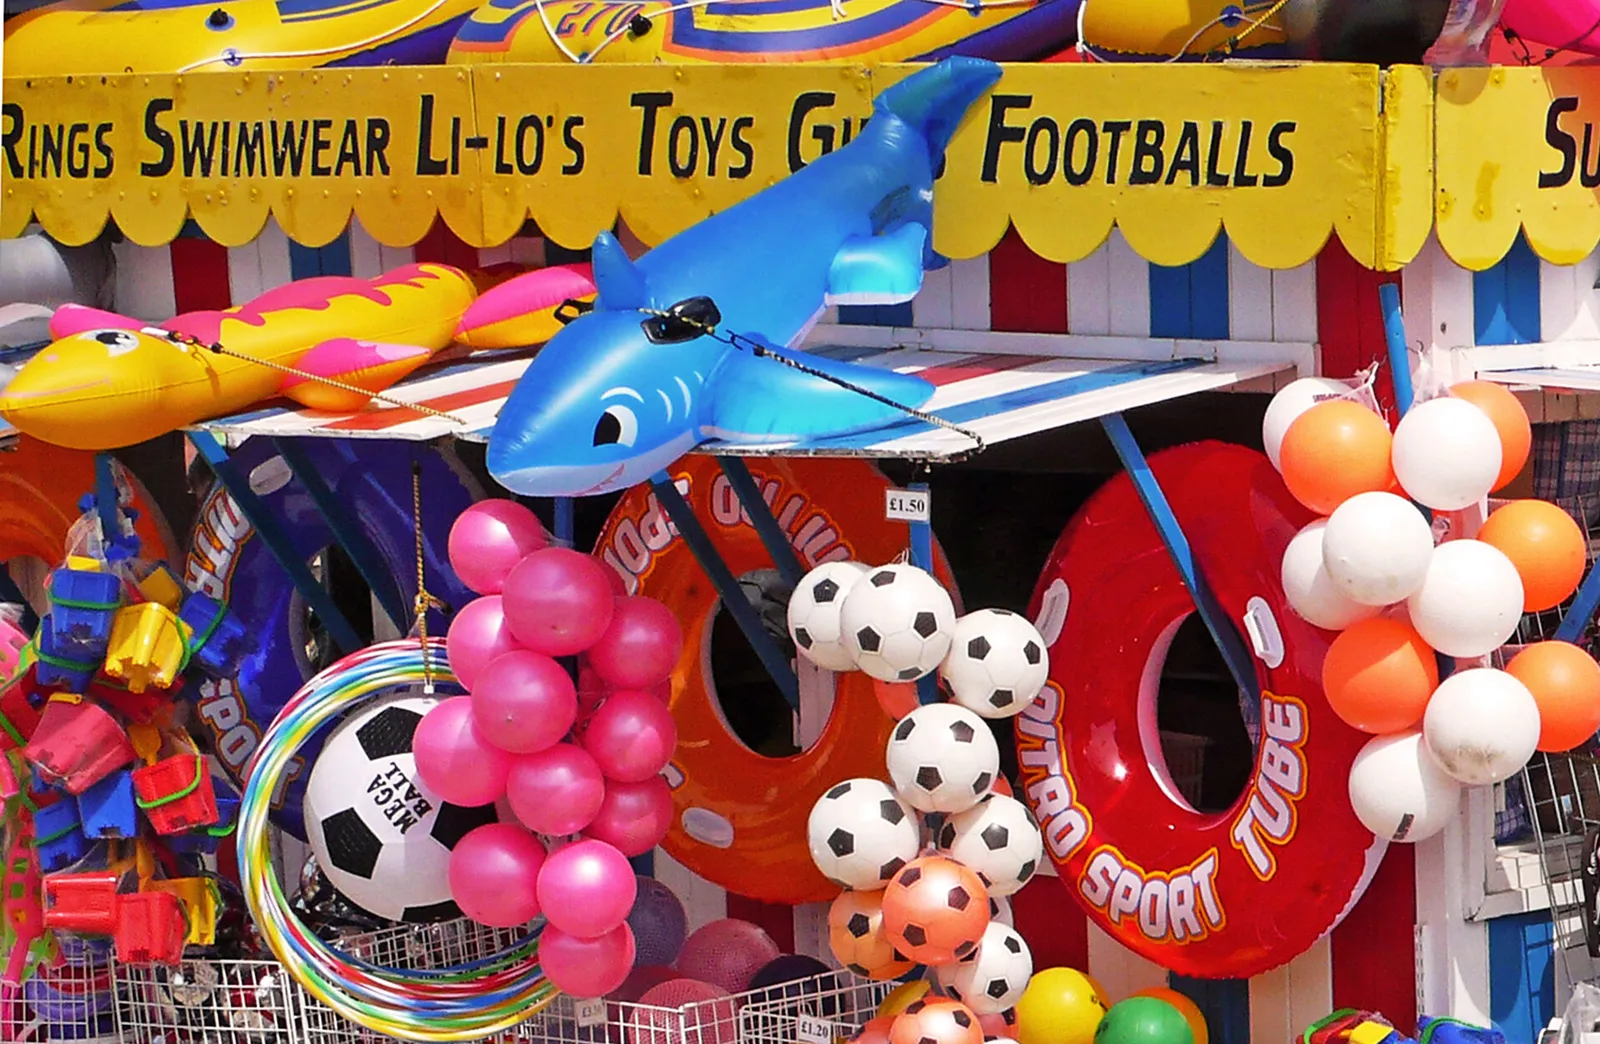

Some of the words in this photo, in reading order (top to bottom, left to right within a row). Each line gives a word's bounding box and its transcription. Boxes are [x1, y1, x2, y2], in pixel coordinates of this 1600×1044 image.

[1, 103, 114, 179] RINGS
[140, 98, 391, 178] SWIMWEAR
[416, 94, 586, 175] LI-LO'S
[630, 92, 754, 178] TOYS
[981, 95, 1298, 187] FOOTBALLS
[889, 498, 925, 512] £1.50
[184, 488, 254, 600] NITR
[367, 773, 418, 834] MEGA
[384, 762, 433, 818] BALL
[1079, 849, 1225, 943] SPORT
[1231, 695, 1306, 877] TUBE
[801, 1021, 829, 1038] £1.20
